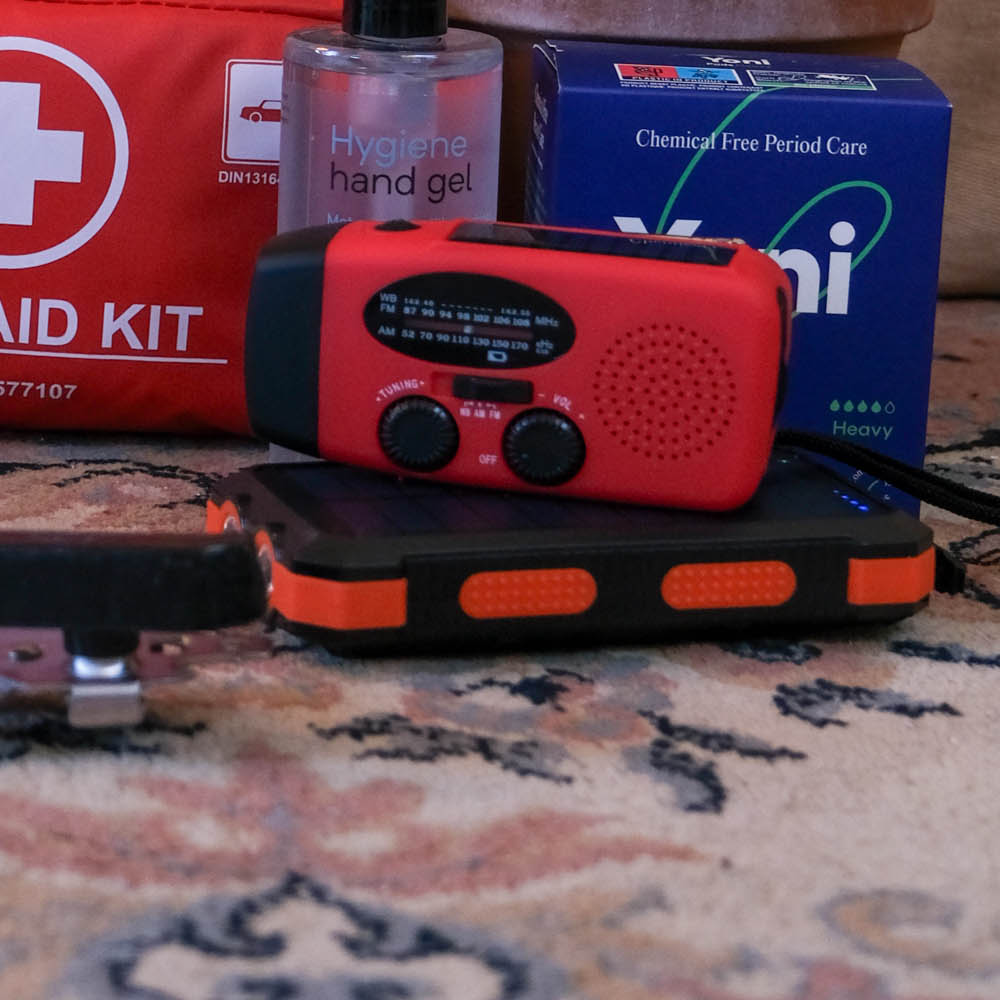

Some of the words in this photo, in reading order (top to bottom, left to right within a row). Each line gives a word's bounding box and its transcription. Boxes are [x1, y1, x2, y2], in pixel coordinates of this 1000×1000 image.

[701, 57, 771, 65] Yoni
[330, 124, 467, 168] Hygiene
[635, 128, 716, 150] Chemical
[721, 132, 759, 152] Free
[764, 133, 821, 154] Period
[826, 135, 868, 156] Care
[218, 171, 281, 184] DIN1316
[330, 161, 416, 195] hand
[427, 162, 472, 204] gel
[379, 304, 396, 314] FM
[403, 306, 418, 315] 87
[421, 308, 435, 318] 90
[439, 310, 452, 319] 94
[101, 302, 204, 352] KIT
[378, 326, 396, 337] AM
[419, 331, 433, 341] 70
[436, 332, 450, 342] 90
[452, 334, 470, 344] 110
[379, 378, 419, 398] TUNING
[832, 420, 894, 440] Heavy
[478, 453, 497, 465] OFF
